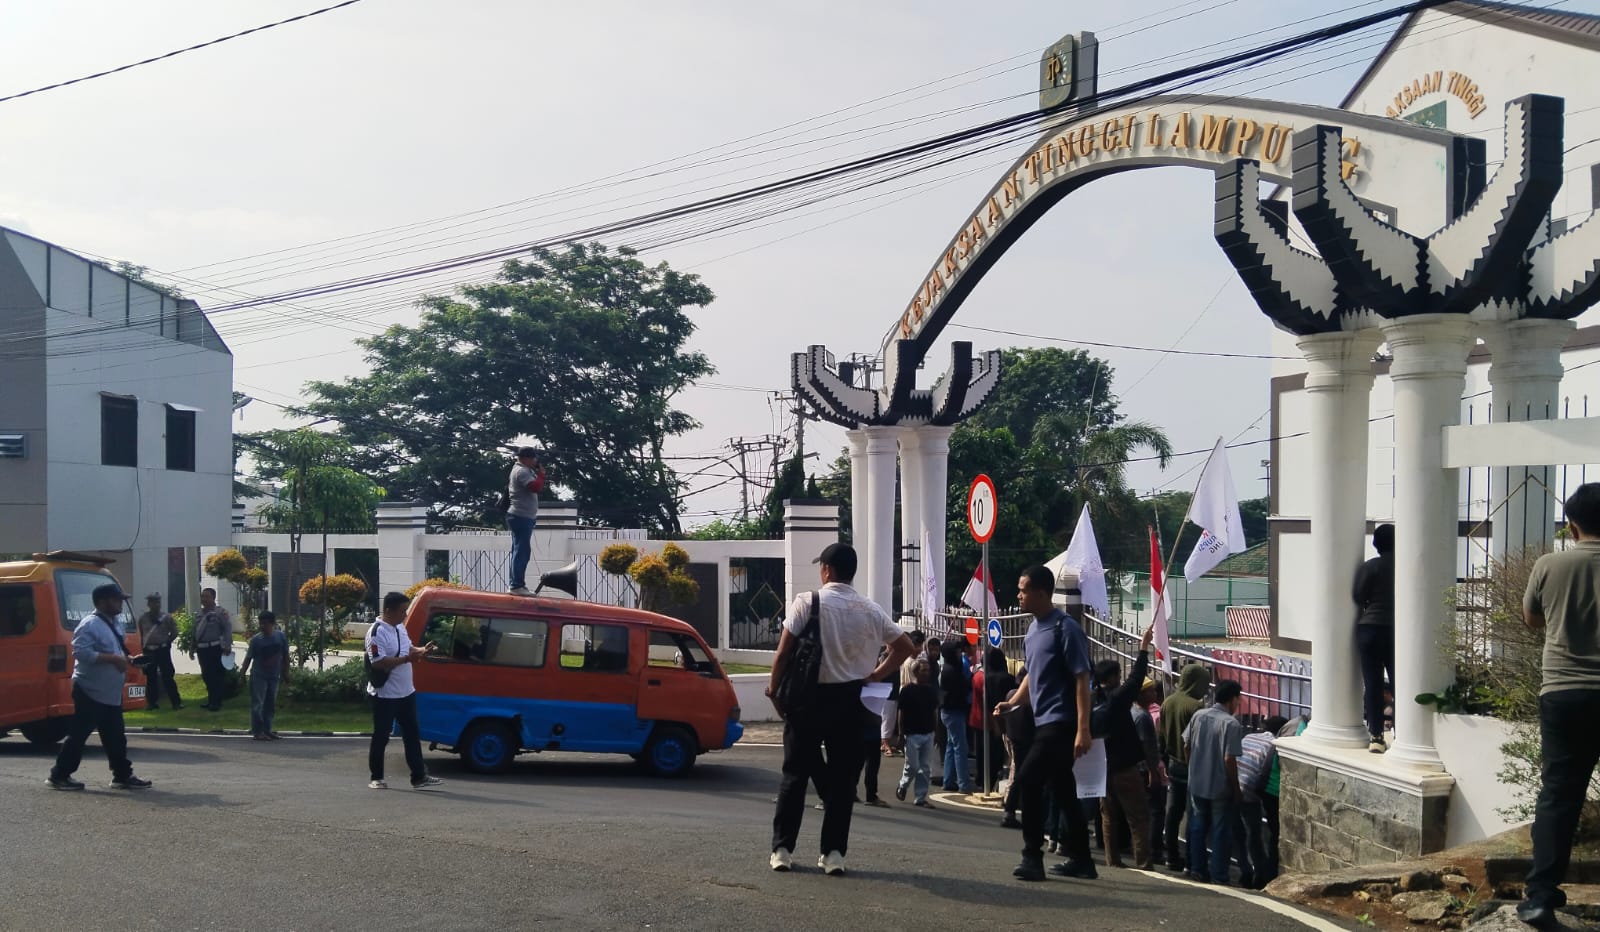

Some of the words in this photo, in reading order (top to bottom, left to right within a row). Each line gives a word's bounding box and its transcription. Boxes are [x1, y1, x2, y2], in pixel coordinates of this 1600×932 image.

[1385, 70, 1443, 119] AKSAAN
[1447, 70, 1488, 120] TINGGI
[900, 170, 1019, 339] KEJAKSAAN
[1024, 115, 1137, 185] TINGGI
[1144, 111, 1361, 181] LAMPUG
[973, 498, 984, 525] 10
